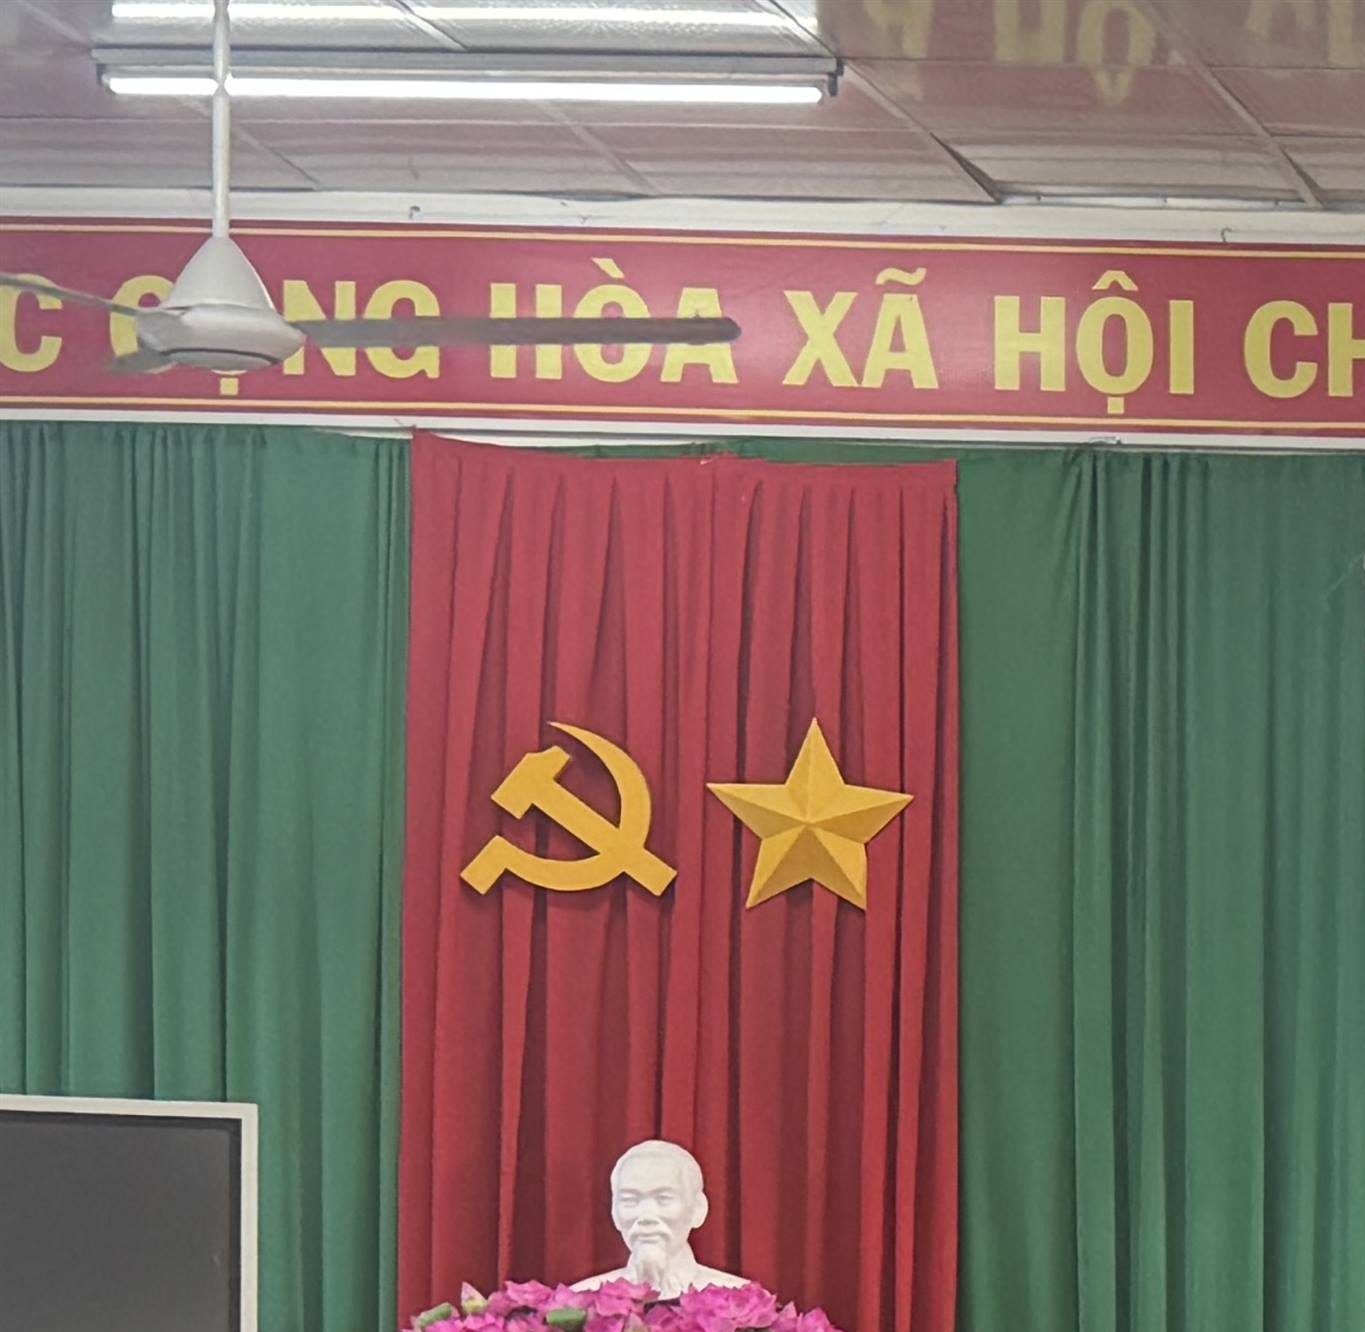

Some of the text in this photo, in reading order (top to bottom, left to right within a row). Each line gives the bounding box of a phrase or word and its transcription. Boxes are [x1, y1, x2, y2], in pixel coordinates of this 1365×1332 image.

[489, 257, 739, 383] HÒA
[782, 267, 940, 390] XÃ
[994, 270, 1196, 415] HỘI
